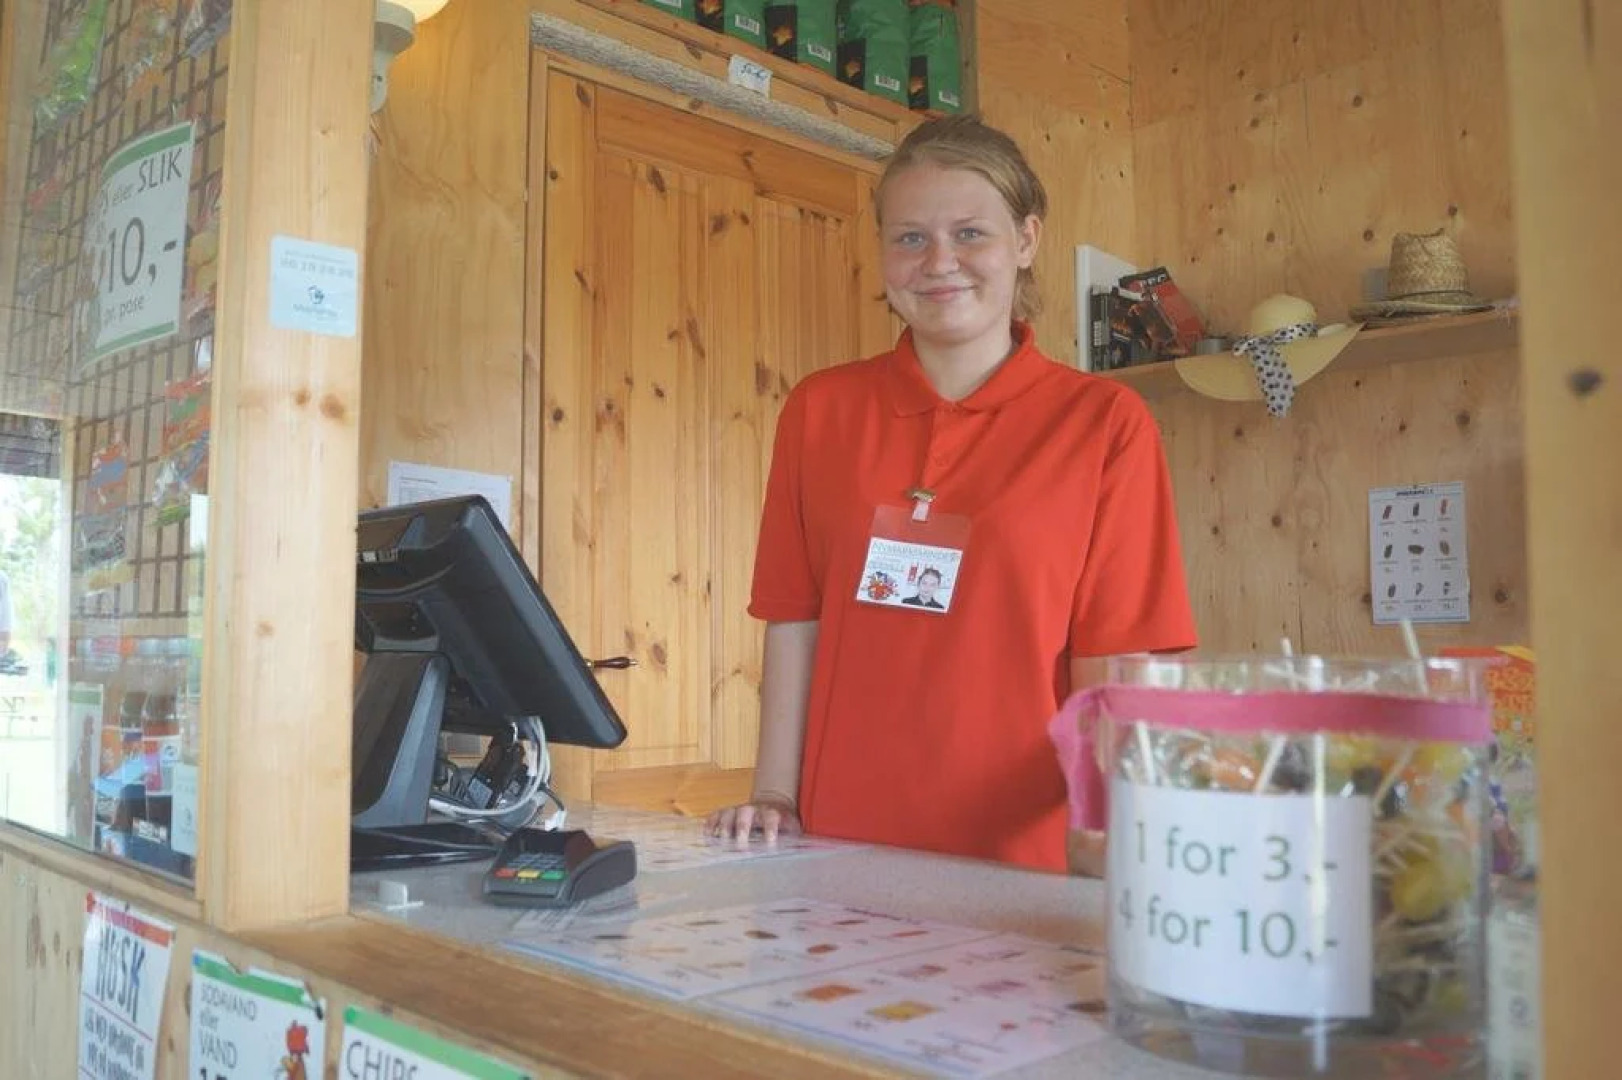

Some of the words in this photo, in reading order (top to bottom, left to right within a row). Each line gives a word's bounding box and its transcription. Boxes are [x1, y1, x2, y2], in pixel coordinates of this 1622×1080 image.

[137, 147, 183, 193] SLIK
[107, 216, 178, 294] 10,-
[1136, 821, 1147, 863] 1
[1165, 825, 1236, 877] for
[1119, 886, 1133, 929] 4
[1147, 895, 1211, 948] for
[198, 1026, 238, 1069] VAND
